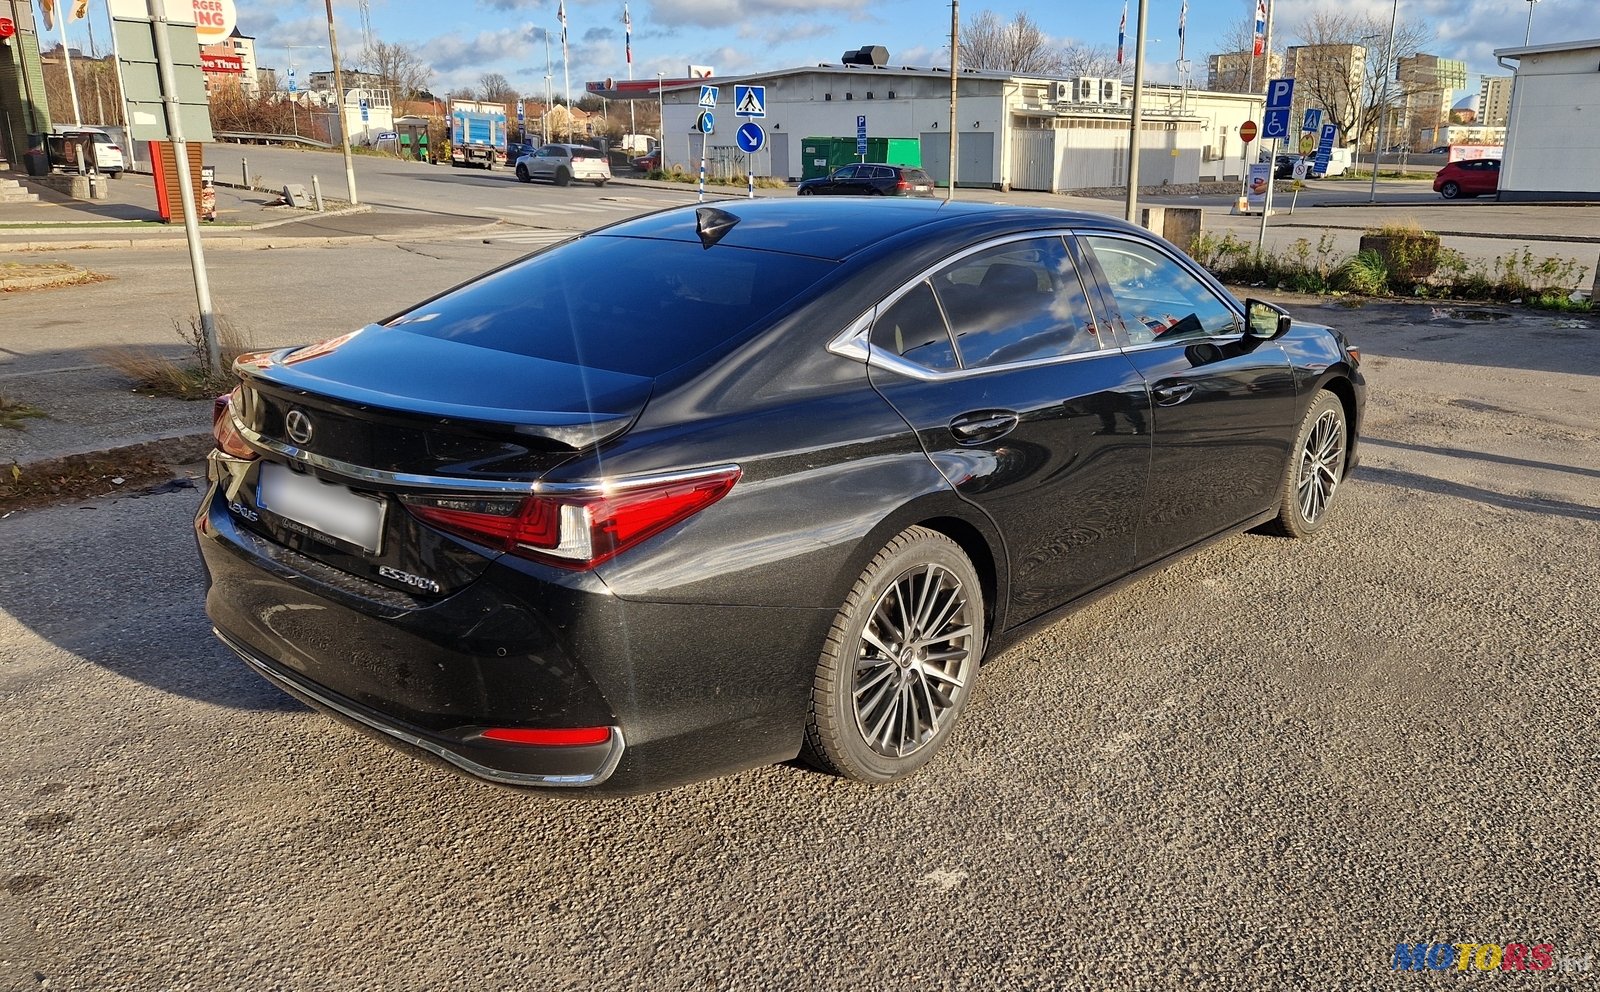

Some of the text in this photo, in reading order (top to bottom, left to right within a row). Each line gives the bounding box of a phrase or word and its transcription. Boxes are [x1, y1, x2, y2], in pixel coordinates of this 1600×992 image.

[192, 0, 222, 11] RGER
[193, 10, 224, 26] ING
[214, 59, 240, 69] Thru
[1273, 81, 1289, 105] P
[1324, 126, 1334, 138] P
[229, 500, 258, 522] LEXUS
